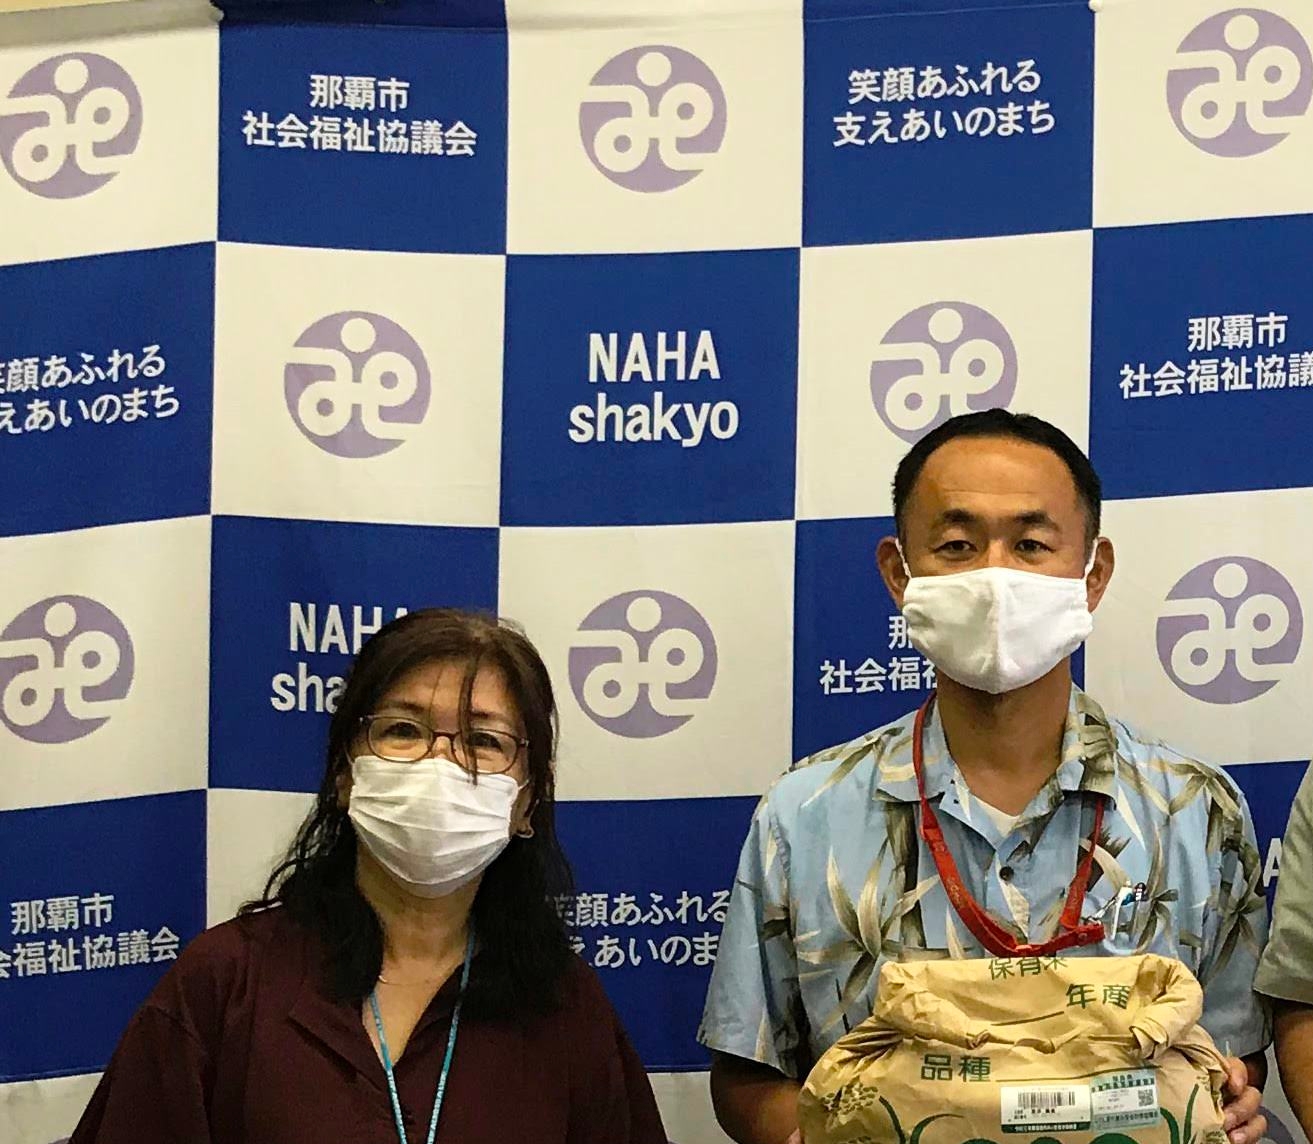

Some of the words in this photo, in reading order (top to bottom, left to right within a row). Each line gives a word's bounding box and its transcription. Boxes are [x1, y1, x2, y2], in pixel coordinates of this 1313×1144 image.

[309, 74, 410, 112] 那覇市
[848, 60, 1042, 104] 笑顔あふれる
[242, 114, 478, 157] 社会福祉協議会
[834, 98, 1055, 147] 支えあいのまち
[1187, 312, 1288, 352] 那覇市
[0, 345, 166, 394] 顔あふれる
[588, 330, 720, 383] NAHA
[568, 392, 739, 447] shakyo
[290, 602, 408, 655] NAH
[11, 892, 115, 935] 那覇市
[921, 1053, 991, 1082] 品種
